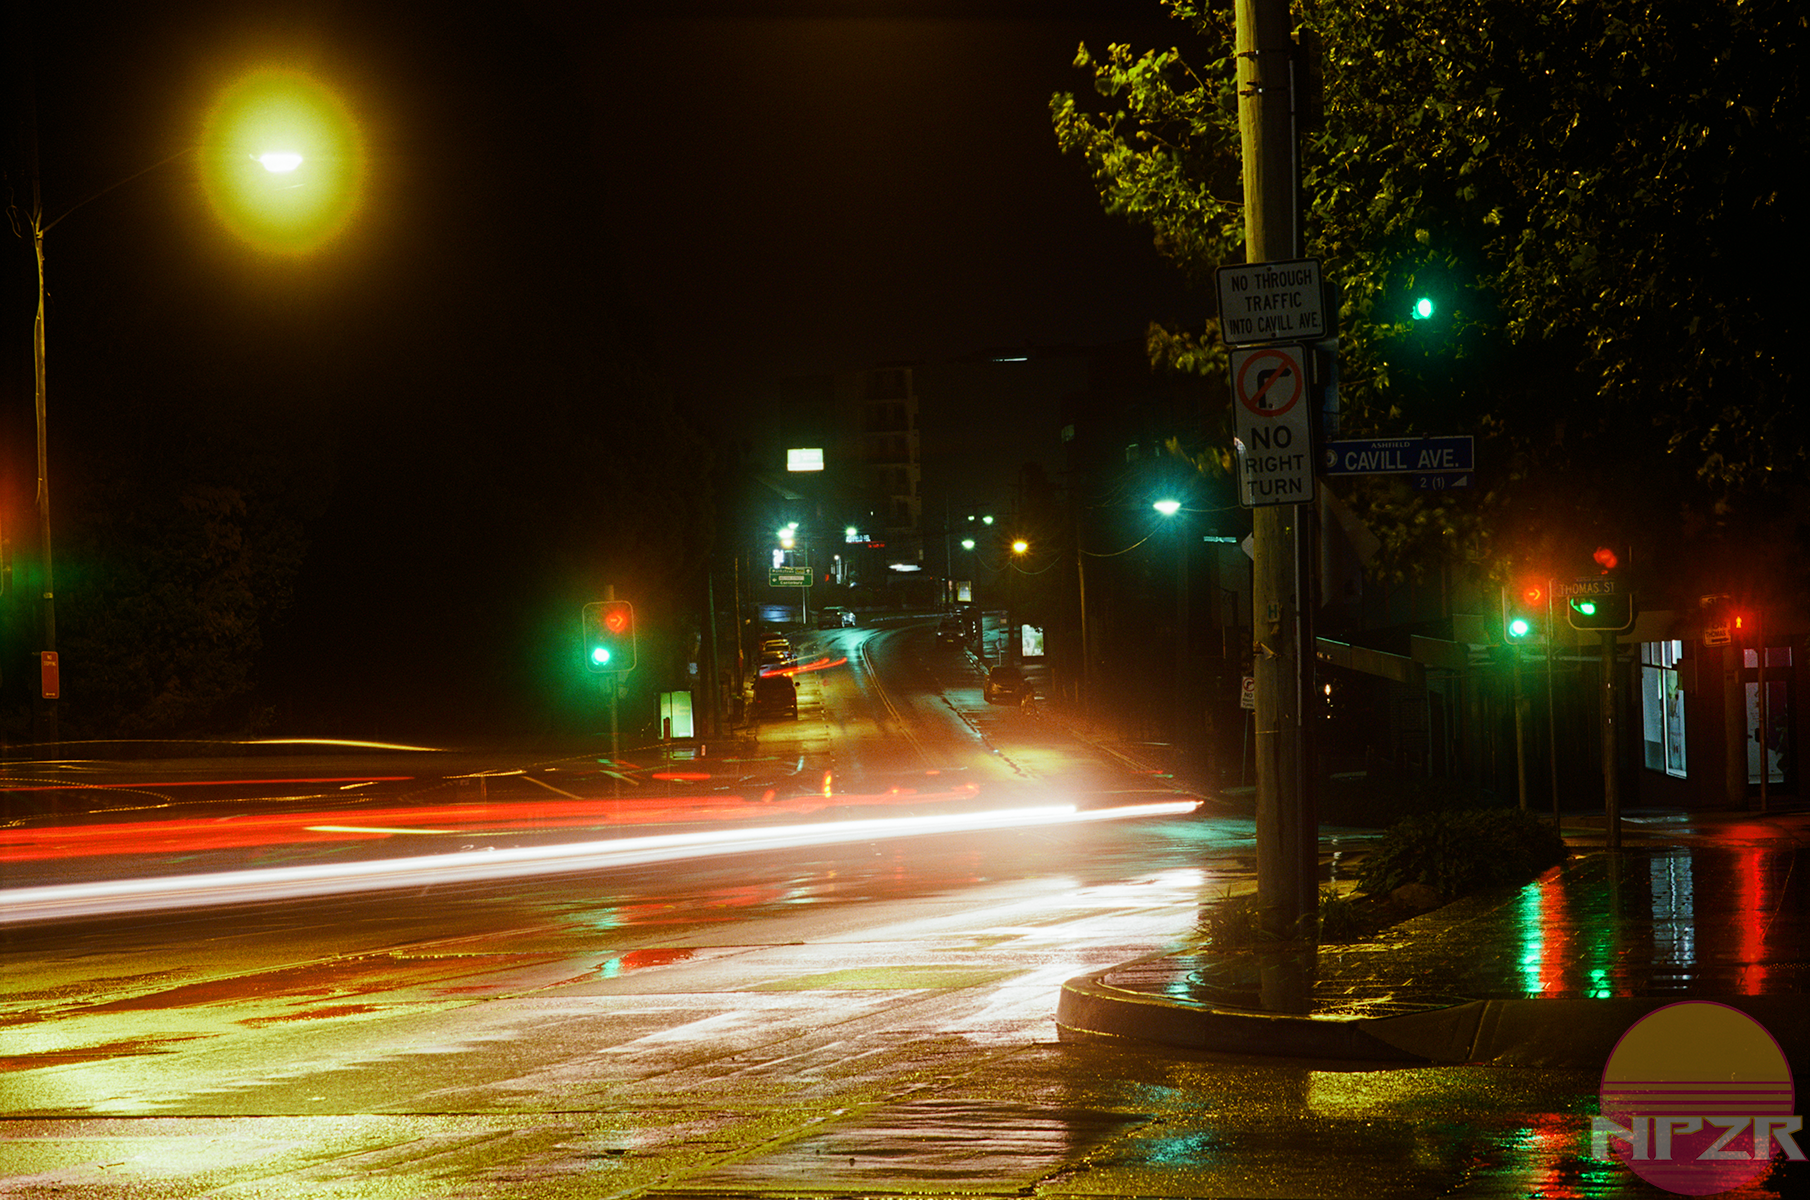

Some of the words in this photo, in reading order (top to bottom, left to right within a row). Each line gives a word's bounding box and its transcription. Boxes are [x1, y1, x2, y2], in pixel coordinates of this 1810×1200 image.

[1231, 276, 1248, 292] NO
[1255, 268, 1312, 290] THROUGH
[1245, 291, 1302, 313] TRAFFIC
[1229, 318, 1251, 335] INTO
[1257, 314, 1293, 333] CAVILL
[1300, 311, 1321, 329] AVE.
[1251, 425, 1292, 450] NO
[1371, 440, 1410, 449] ASHFIELD
[1245, 453, 1304, 475] RIGHT
[1345, 450, 1407, 471] CAVILL
[1418, 448, 1459, 469] AVE.
[1247, 477, 1302, 497] TURN
[1560, 581, 1600, 595] THOMAS
[1604, 581, 1615, 593] ST
[1268, 604, 1277, 618] H
